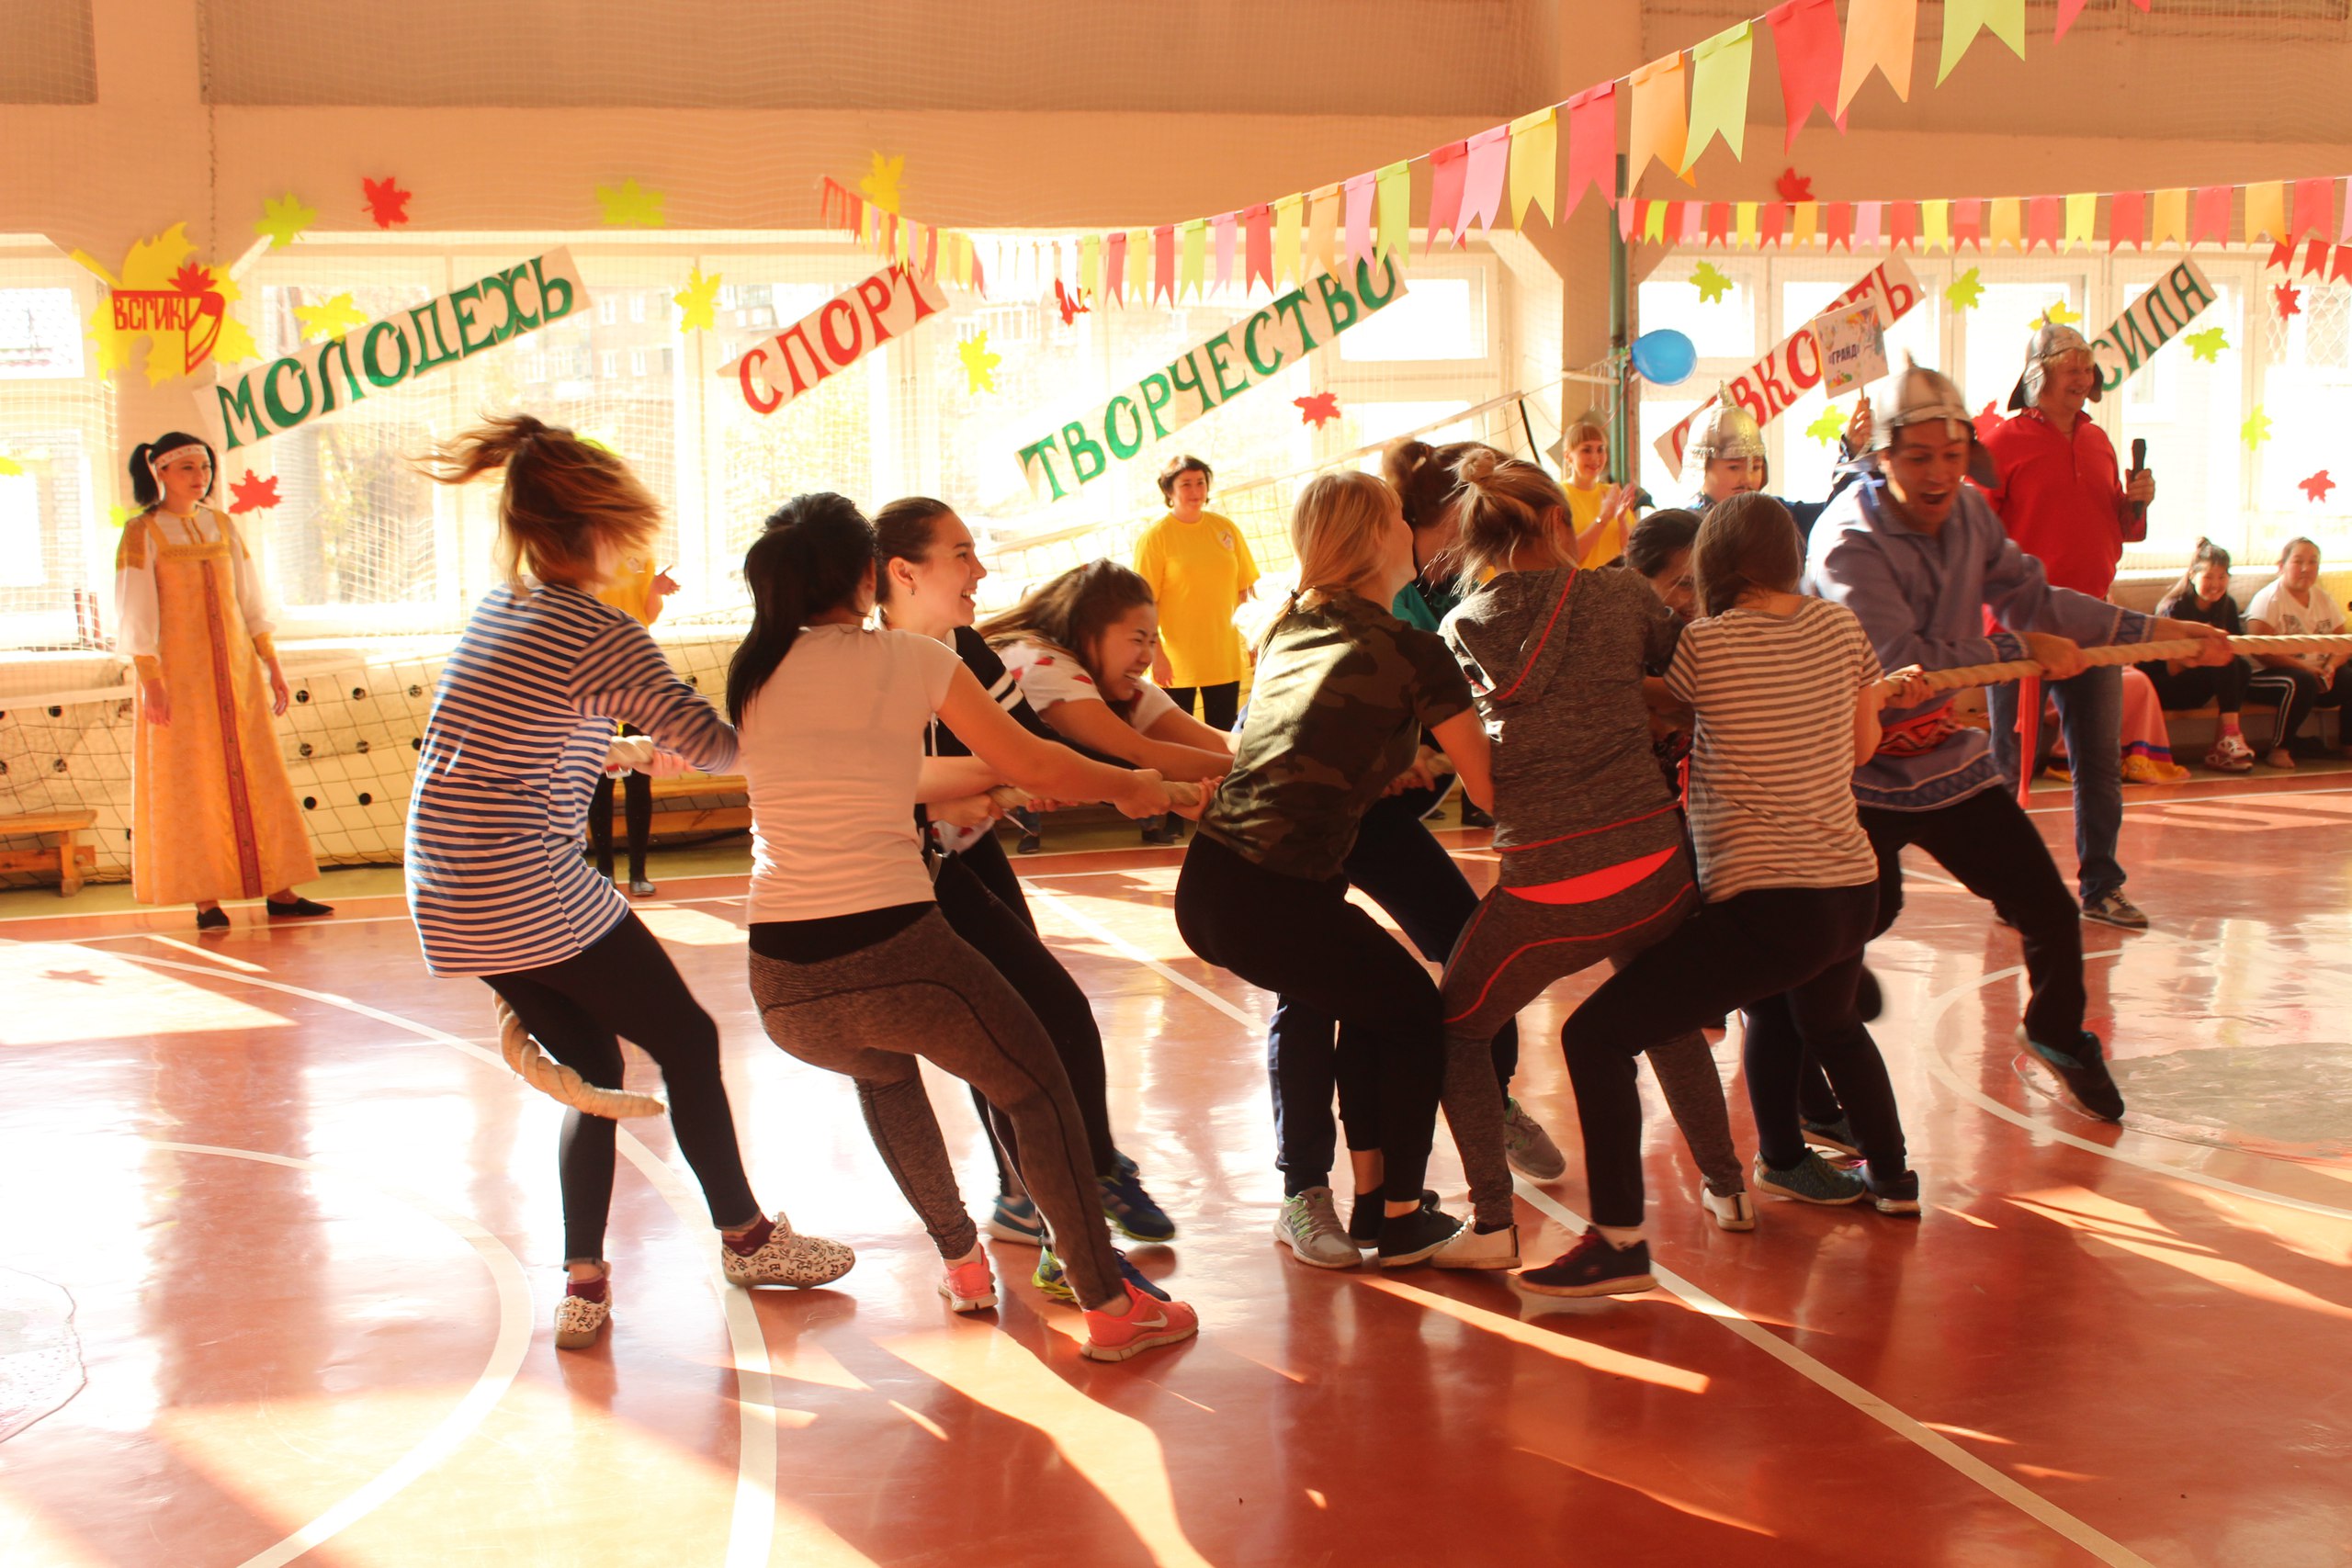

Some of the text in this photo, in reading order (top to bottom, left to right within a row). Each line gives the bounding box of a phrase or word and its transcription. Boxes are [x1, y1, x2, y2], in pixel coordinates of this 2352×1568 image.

[112, 289, 187, 331] ВСГИК
[216, 255, 574, 451] МОЛОДЕЖЬ
[740, 257, 937, 414] СПОРТ
[1019, 246, 1396, 502] ТВОРЧЕСТВО
